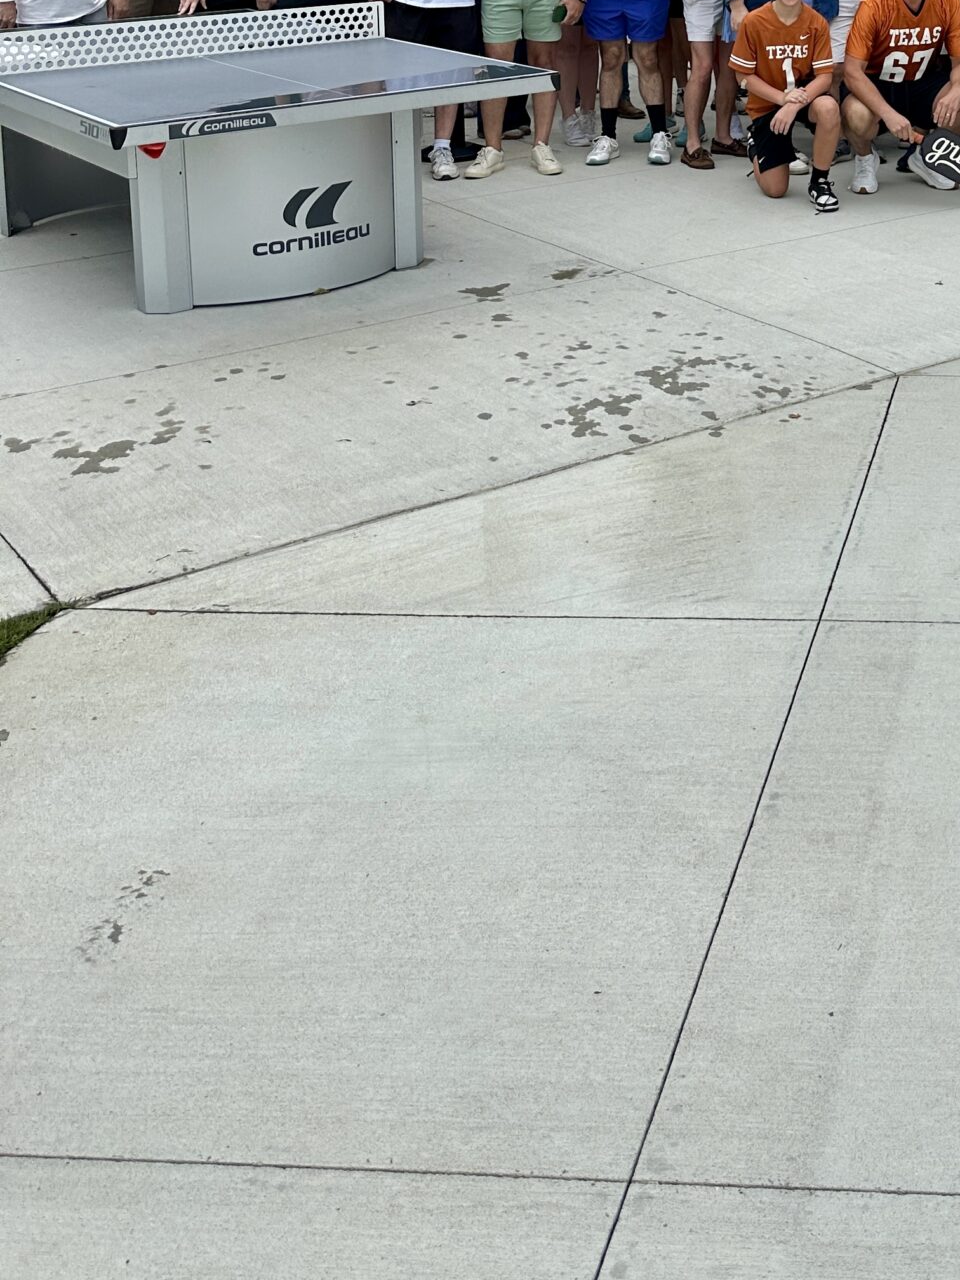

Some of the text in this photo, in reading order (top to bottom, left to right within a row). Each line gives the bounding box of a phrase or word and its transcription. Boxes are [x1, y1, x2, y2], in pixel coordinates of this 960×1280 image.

[889, 26, 943, 47] TEXAS
[766, 44, 809, 60] TEXAS
[878, 48, 936, 84] 67
[781, 57, 796, 93] 1
